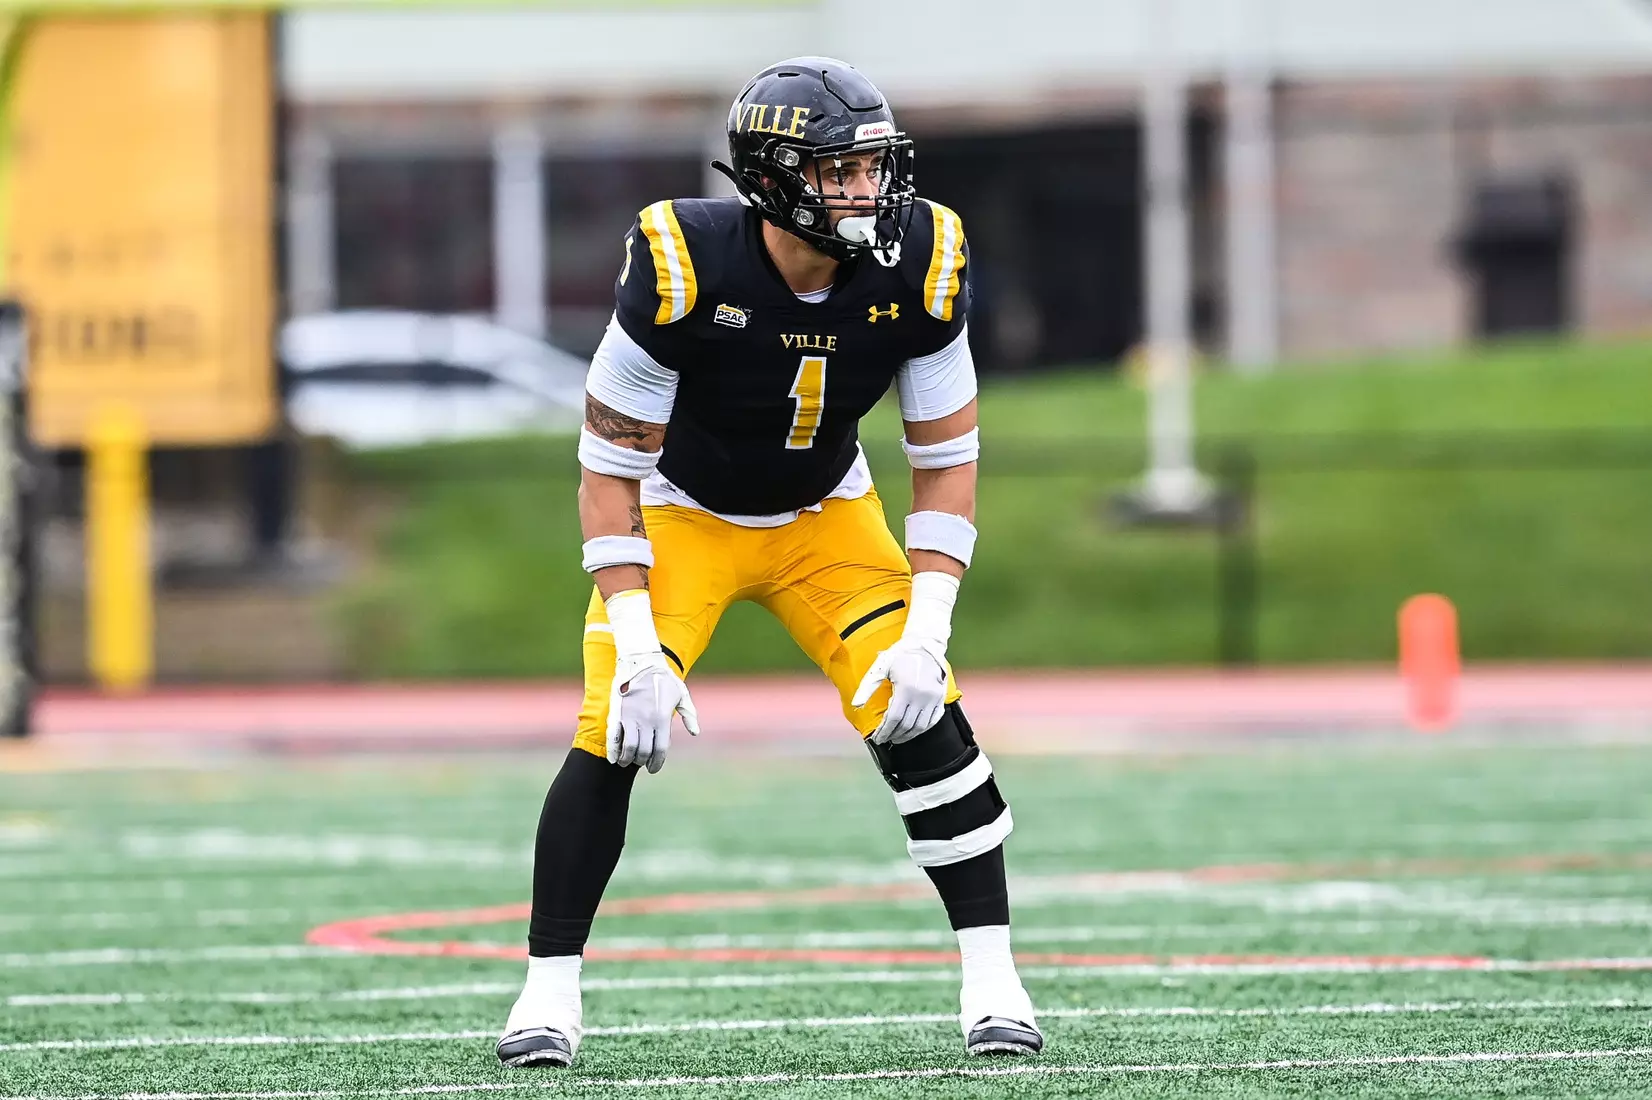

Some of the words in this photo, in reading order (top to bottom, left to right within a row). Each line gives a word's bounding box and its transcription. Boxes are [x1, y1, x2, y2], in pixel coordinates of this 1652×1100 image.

[735, 103, 811, 140] VILLE
[716, 309, 744, 324] PSAC
[780, 333, 838, 352] VILLE
[784, 356, 828, 450] 1
